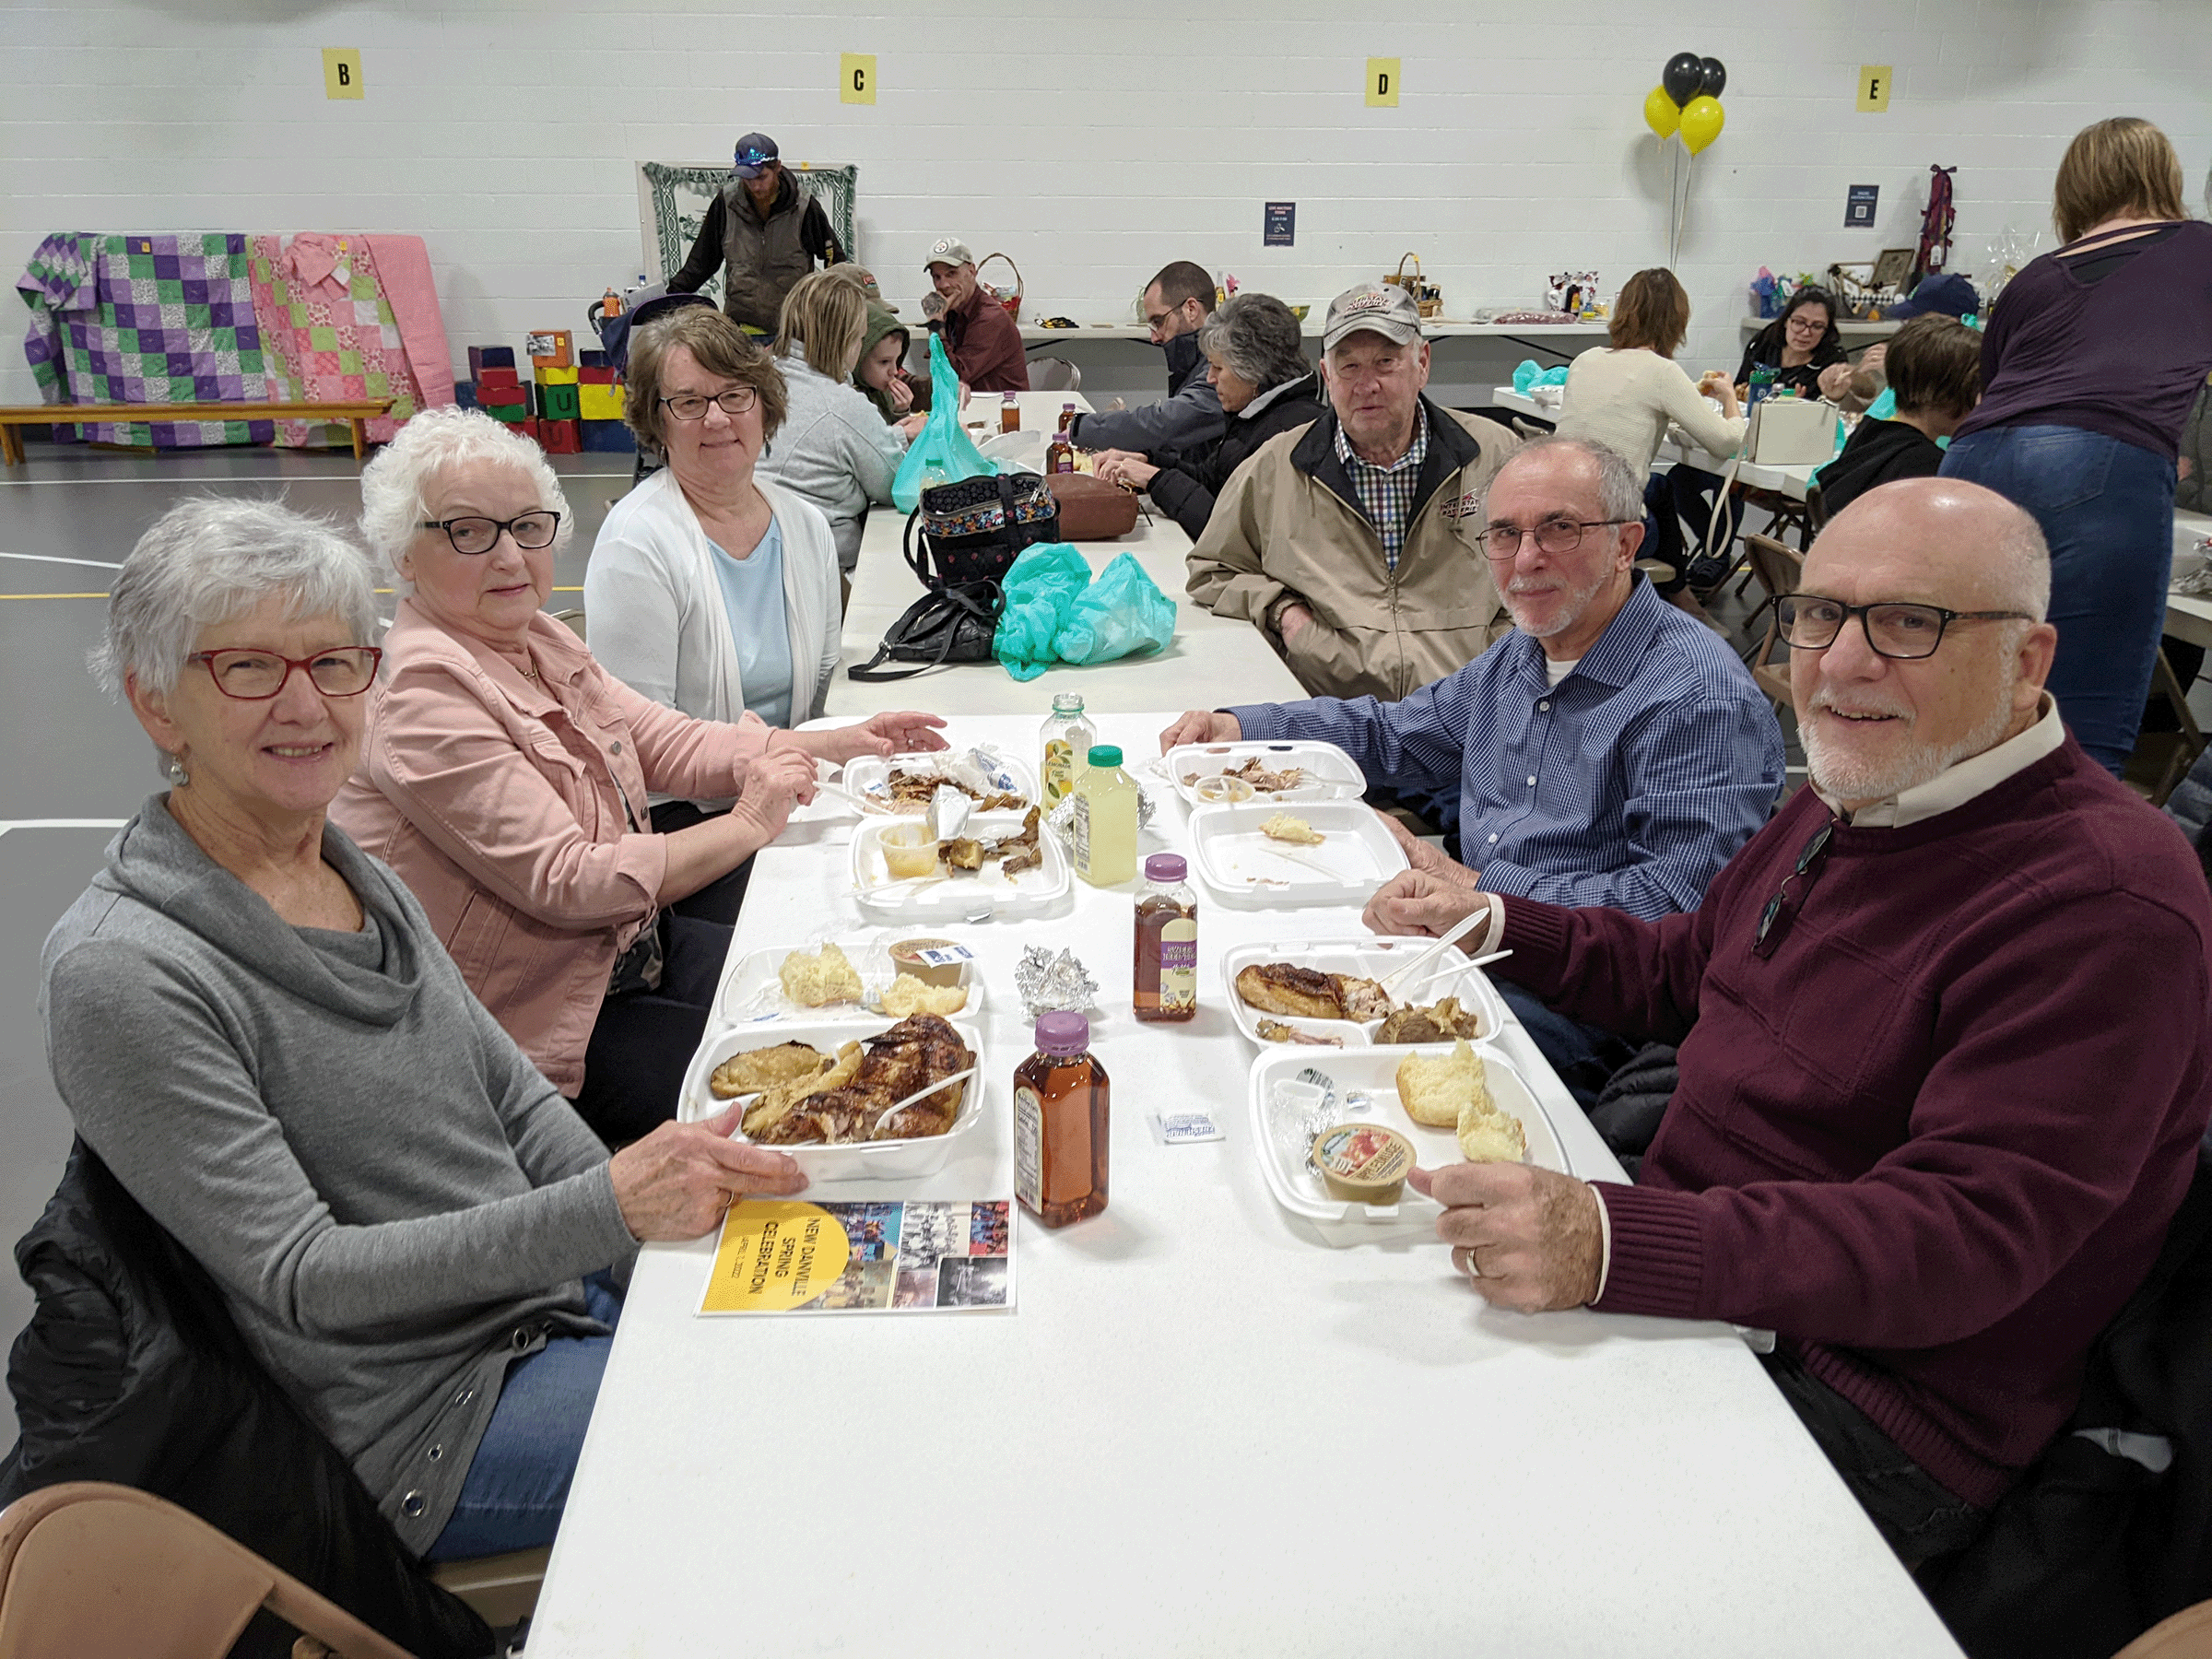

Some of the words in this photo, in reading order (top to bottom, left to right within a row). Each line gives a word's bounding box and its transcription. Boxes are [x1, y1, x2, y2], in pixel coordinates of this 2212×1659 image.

[338, 64, 349, 85] B
[853, 70, 865, 91] C
[1379, 75, 1389, 95] D
[1870, 79, 1879, 100] E
[555, 392, 572, 412] U
[803, 1217, 821, 1245] NEW
[747, 1220, 779, 1295] CELEBRATION
[775, 1236, 796, 1278] SPRING
[792, 1246, 816, 1297] DANVILLE
